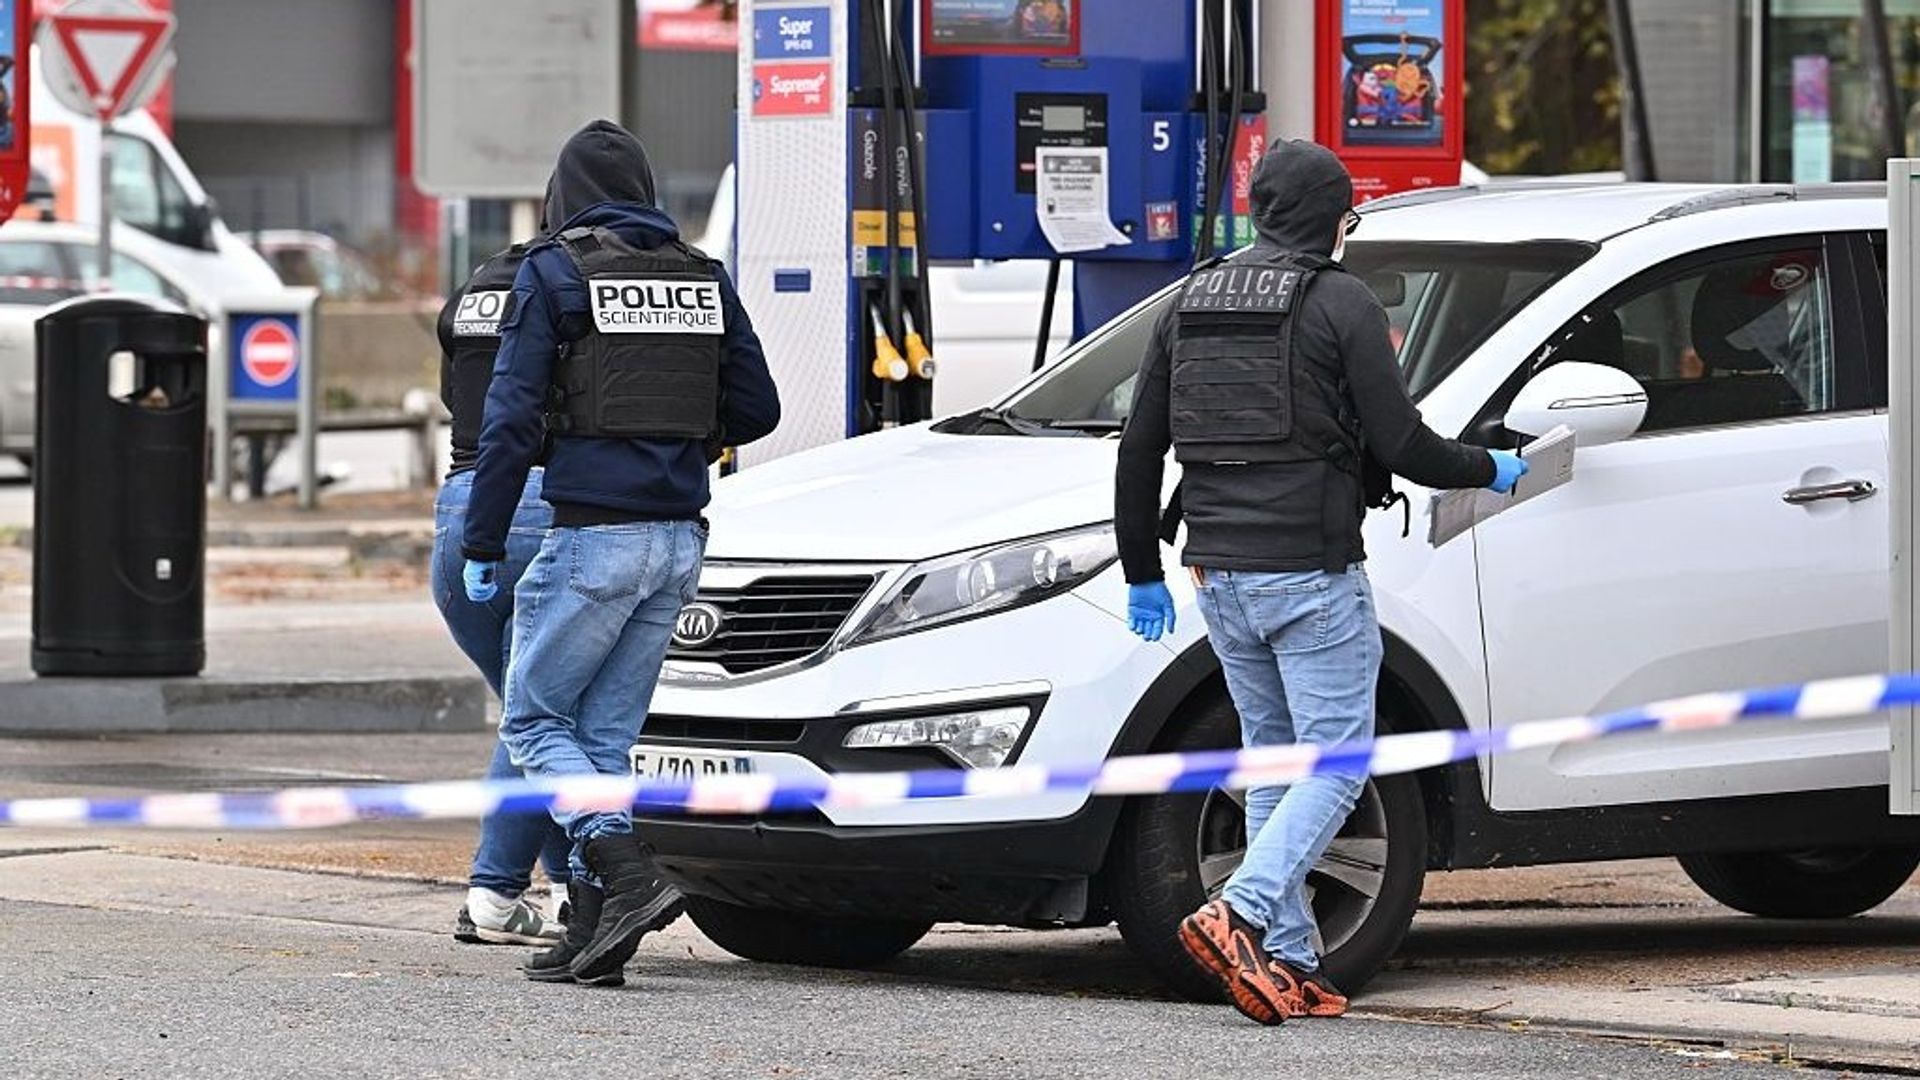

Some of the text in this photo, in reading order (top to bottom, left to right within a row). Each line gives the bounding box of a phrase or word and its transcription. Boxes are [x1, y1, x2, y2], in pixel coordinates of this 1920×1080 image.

[779, 17, 813, 39] Super
[1153, 121, 1170, 151] 5
[864, 130, 878, 180] Gazole
[1187, 269, 1295, 296] POLICE
[597, 285, 716, 310] POLICE
[600, 311, 718, 327] SCIENTIFIQUE
[676, 613, 708, 636] KIA
